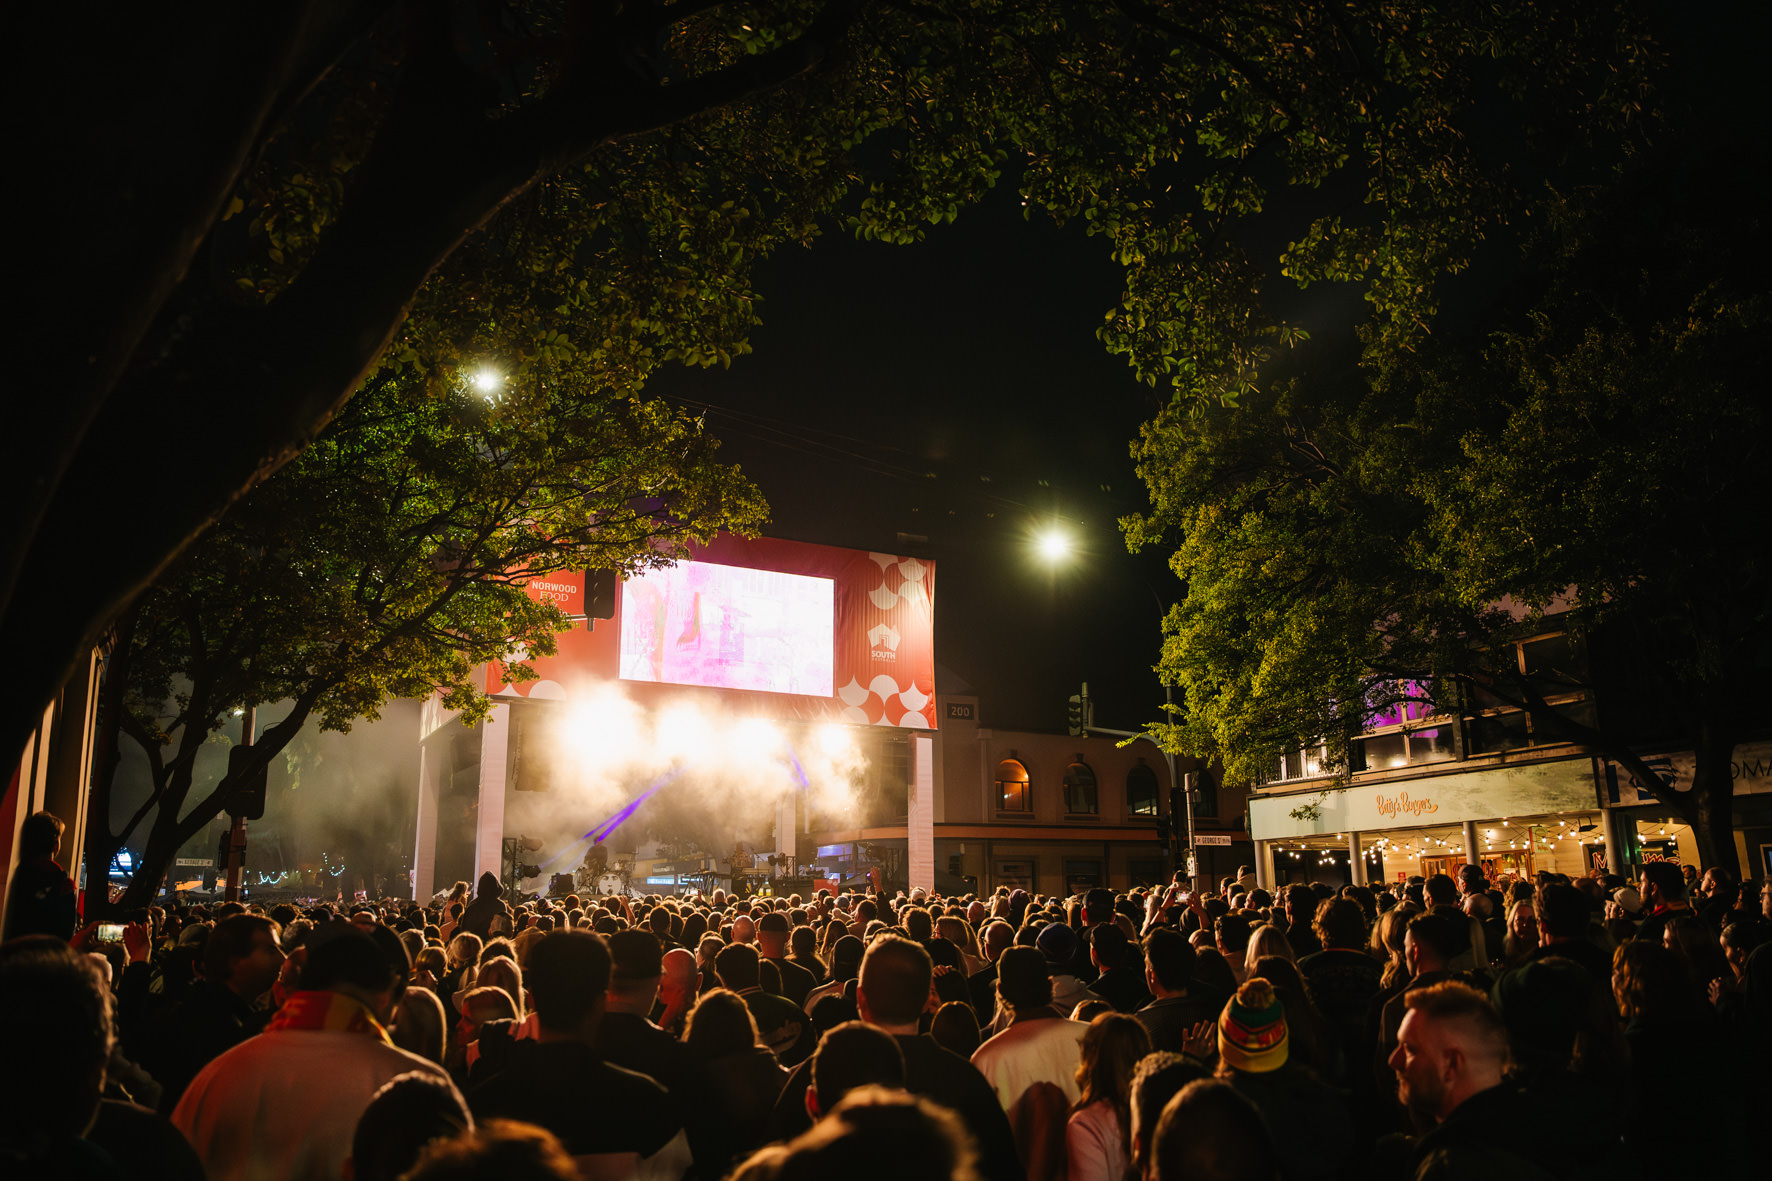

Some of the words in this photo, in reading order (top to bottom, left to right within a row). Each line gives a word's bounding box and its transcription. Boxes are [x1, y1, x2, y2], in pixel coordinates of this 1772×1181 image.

[532, 581, 577, 594] NORWOOD
[540, 591, 569, 602] FOOD
[871, 650, 896, 660] SOUTH
[951, 706, 970, 717] 200
[1376, 794, 1401, 819] Betty's
[1400, 791, 1438, 816] Burgers
